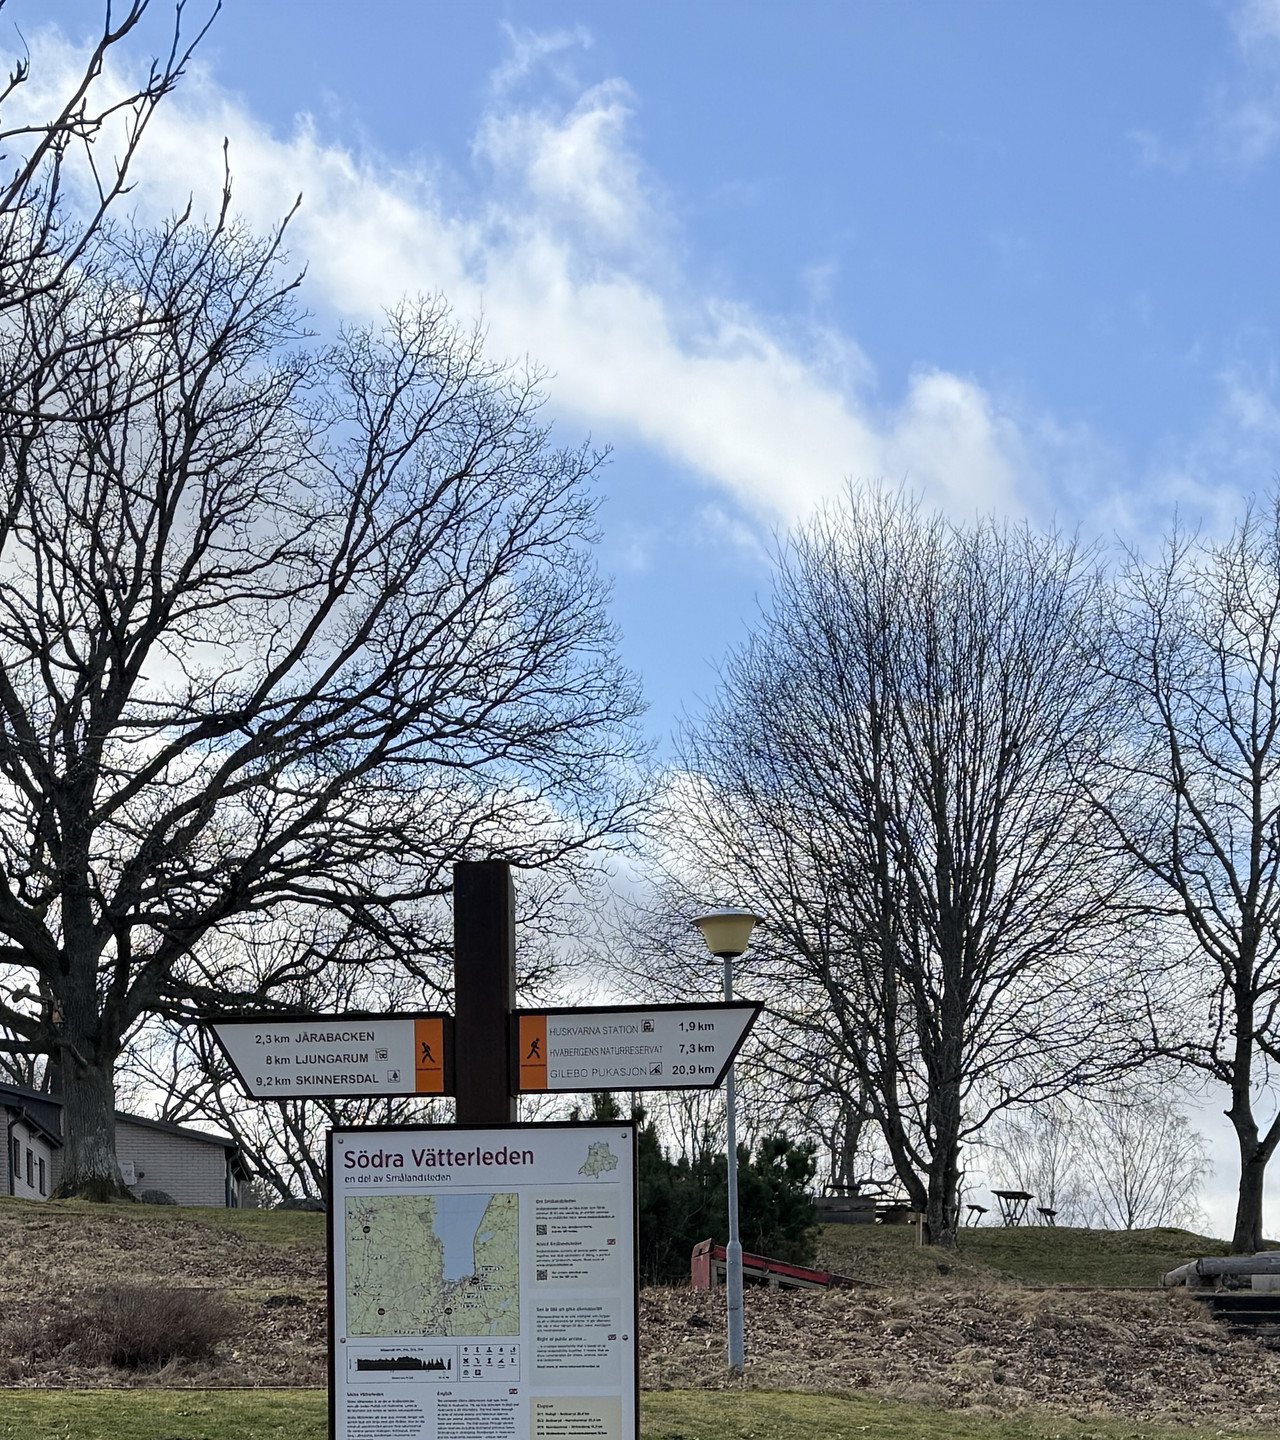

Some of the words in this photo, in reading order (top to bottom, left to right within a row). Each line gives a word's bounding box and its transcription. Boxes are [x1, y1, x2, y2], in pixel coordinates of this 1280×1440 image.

[550, 1026, 600, 1036] HUSKVARNA
[603, 1025, 638, 1035] STATION
[679, 1022, 695, 1032] 1,9
[698, 1022, 714, 1030] km
[256, 1034, 272, 1045] 2,3
[274, 1033, 290, 1043] km
[295, 1032, 375, 1043] JÄRABACKEN
[601, 1046, 663, 1055] NATURRESERVAT
[679, 1044, 695, 1054] 7,3
[698, 1044, 714, 1052] km
[266, 1056, 272, 1065] 8
[275, 1055, 290, 1064] km
[296, 1054, 369, 1064] LJUNGARUM
[672, 1065, 695, 1075] 20,9
[699, 1065, 714, 1073] km
[256, 1077, 272, 1087] 9,2
[275, 1076, 291, 1085] km
[296, 1074, 379, 1085] SKINNERSDAL
[344, 1150, 403, 1168] Södra
[412, 1147, 534, 1167] Vätterleden
